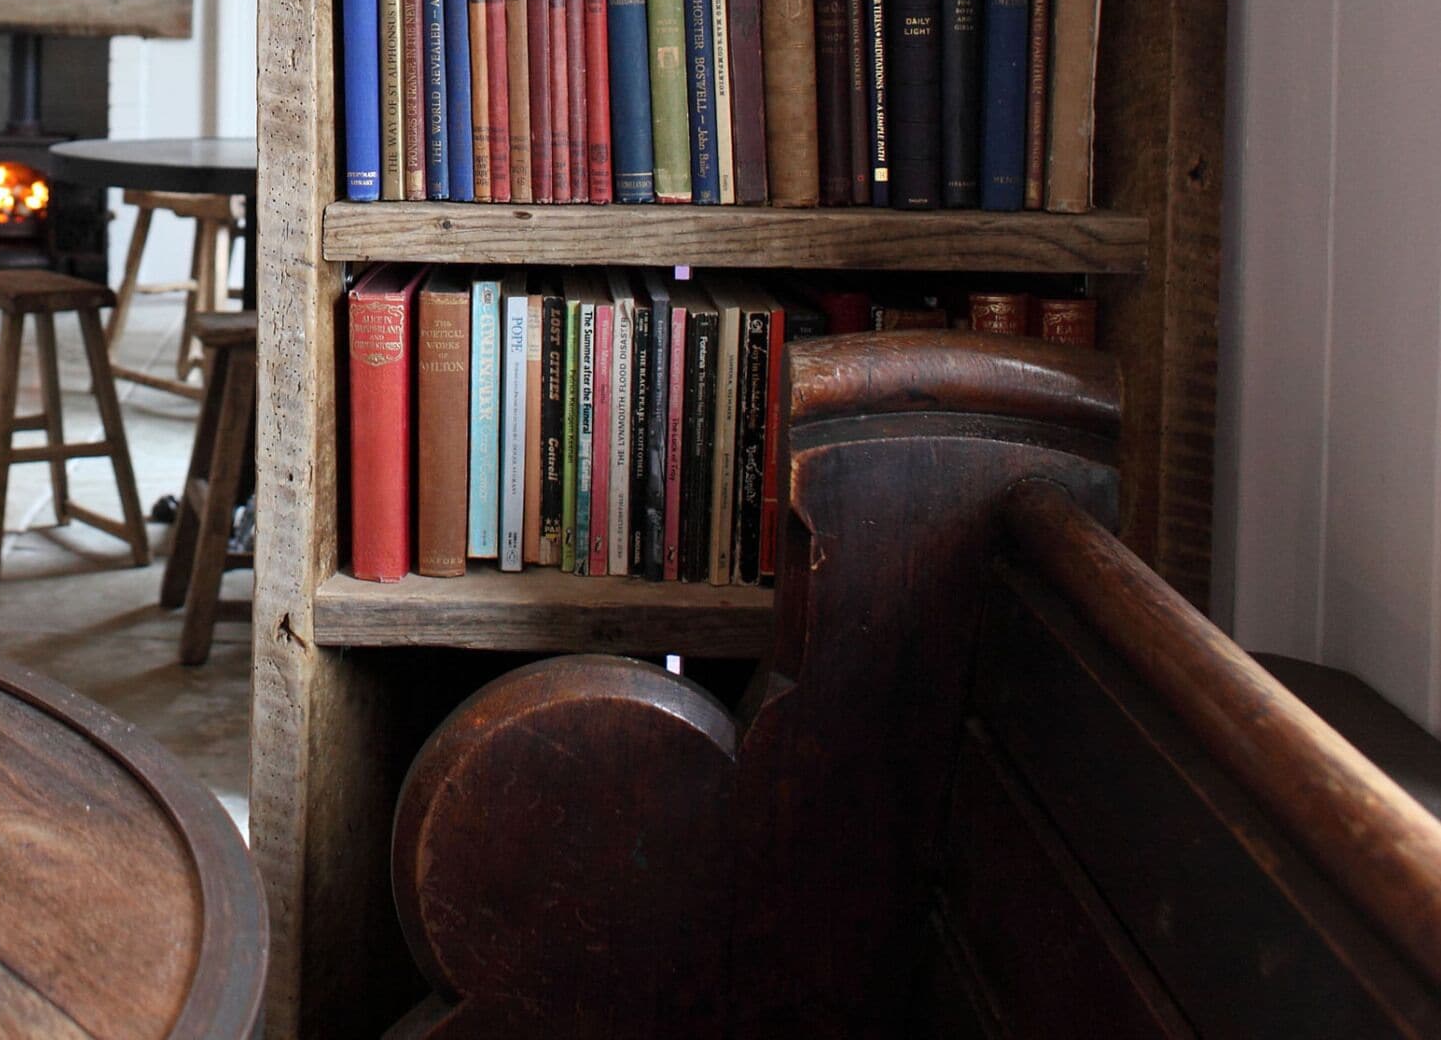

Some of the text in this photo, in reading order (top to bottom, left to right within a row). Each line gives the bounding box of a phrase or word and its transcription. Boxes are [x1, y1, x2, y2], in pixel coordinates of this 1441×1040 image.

[405, 3, 416, 25] NEW
[386, 10, 397, 79] ALPHONSUS
[430, 23, 442, 86] REVEALED
[387, 82, 398, 96] ST
[694, 56, 707, 113] BOSWELL
[388, 98, 398, 116] OF
[431, 90, 442, 135] WORLD
[388, 120, 398, 148] WAY
[696, 126, 709, 151] John
[876, 112, 885, 140] SIMPLE
[388, 152, 398, 175] THE
[432, 140, 443, 165] THE
[877, 140, 885, 161] PATH
[426, 341, 460, 350] WORKS
[511, 317, 524, 352] POPE
[549, 307, 561, 401] LOST CITIES
[698, 335, 708, 368] Fontana
[582, 311, 593, 435] The Summer after the Funeral
[618, 363, 627, 393] FLOOD
[636, 350, 647, 424] THE BLACK PEARL
[618, 397, 626, 447] LYNMOUTH
[671, 417, 679, 432] The
[670, 433, 678, 453] Luck
[547, 437, 559, 481] Cottrell
[617, 450, 625, 466] THE
[668, 463, 678, 481] Troy
